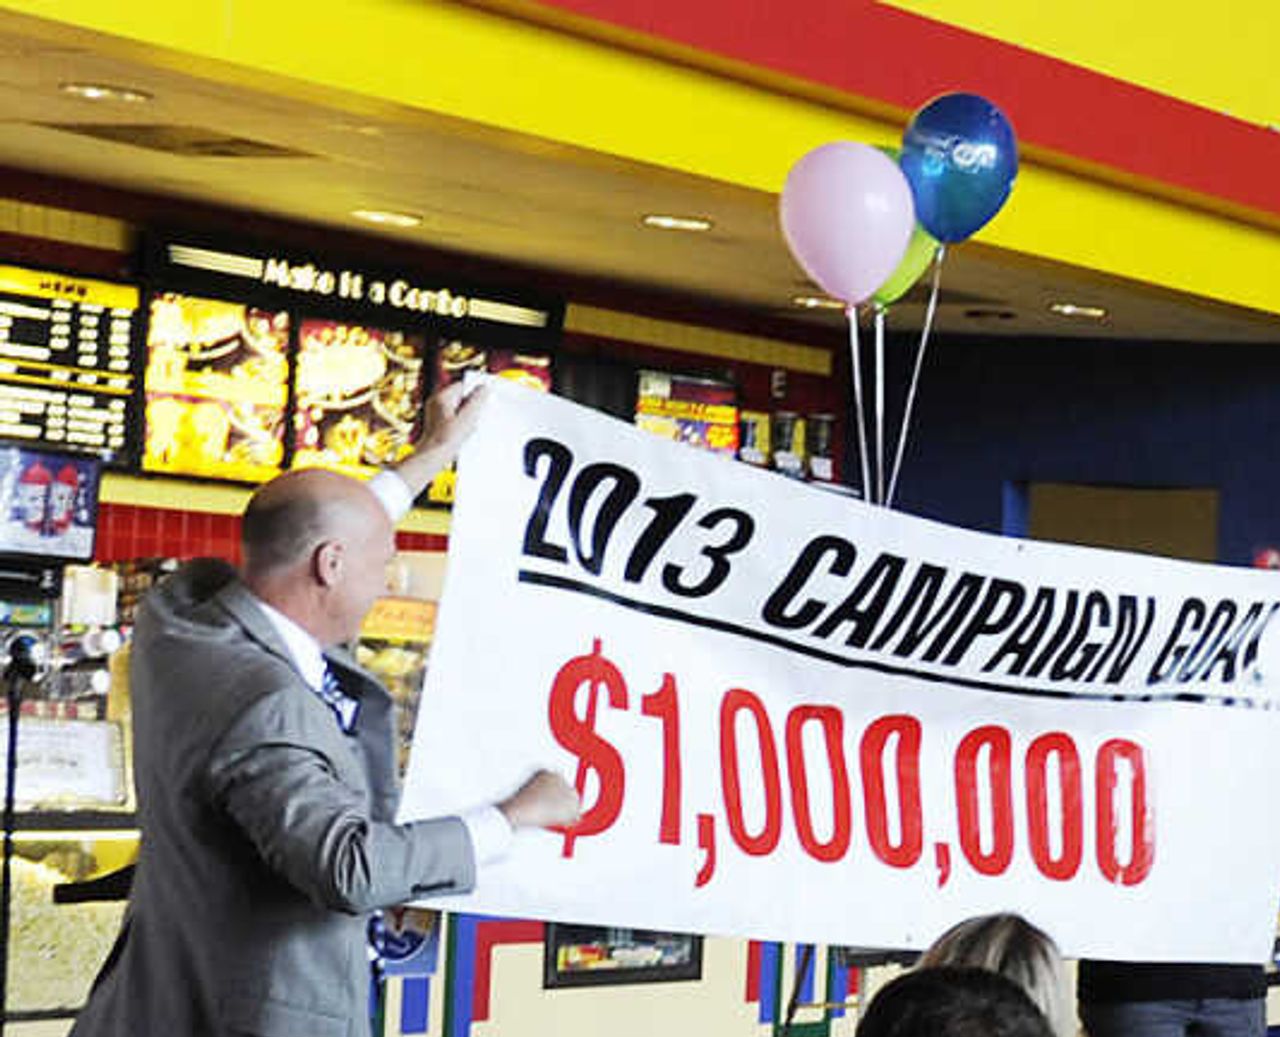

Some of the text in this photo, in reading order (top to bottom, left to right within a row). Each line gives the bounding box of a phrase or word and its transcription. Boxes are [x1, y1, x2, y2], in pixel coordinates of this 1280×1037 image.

[521, 436, 756, 600] 2013
[761, 534, 1156, 684] CAMPAIGN
[547, 637, 1154, 889] $1,000,000
